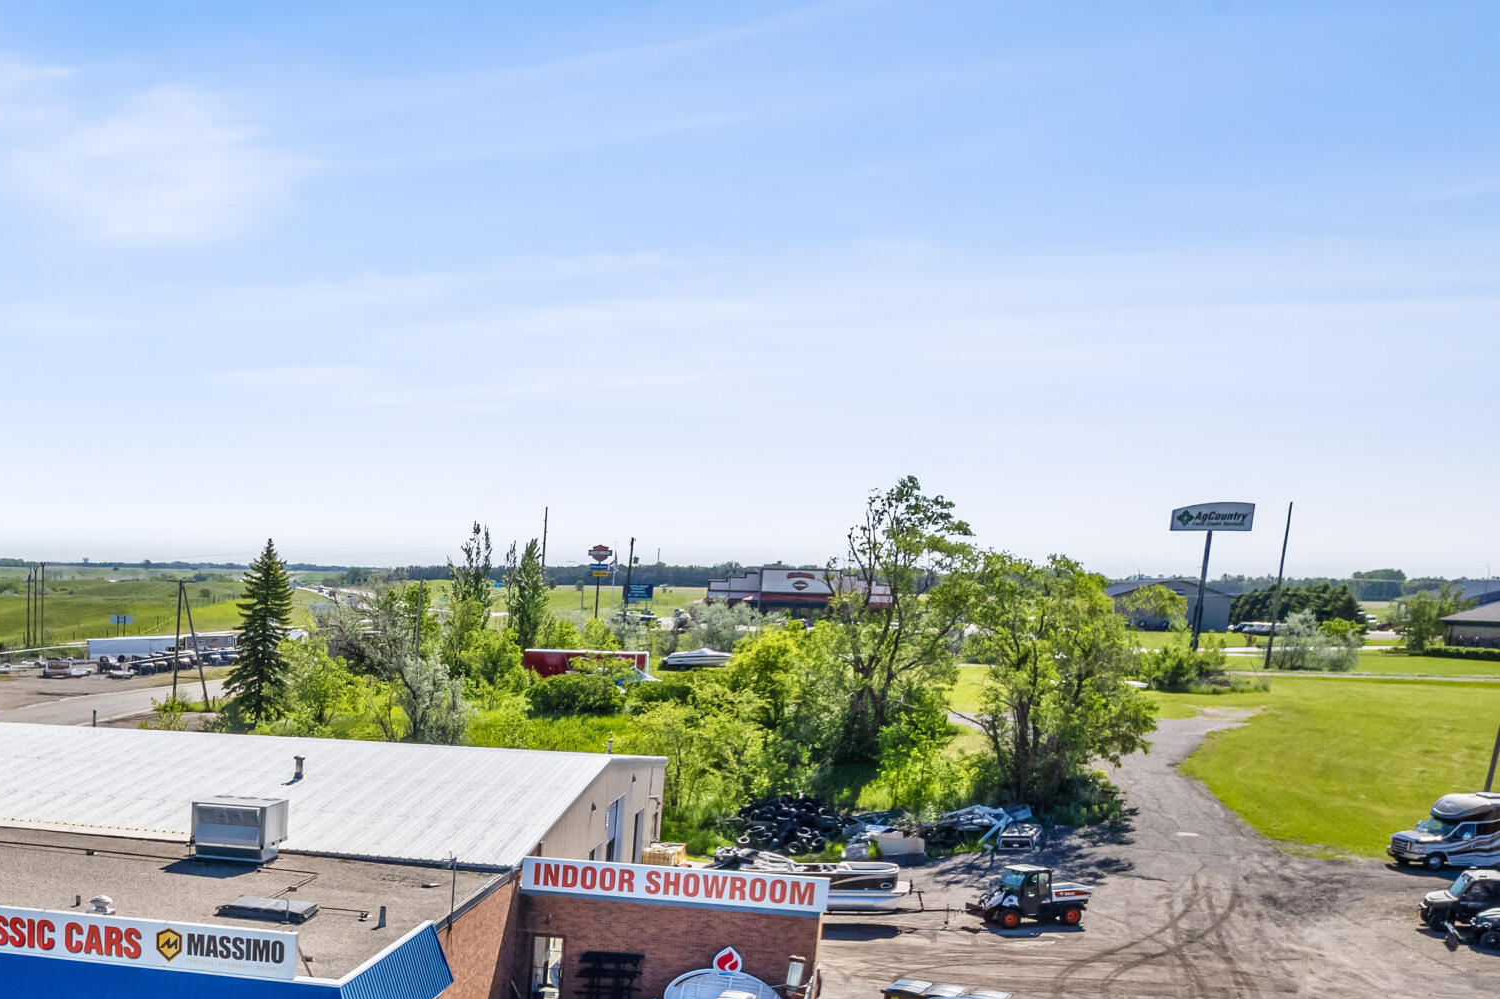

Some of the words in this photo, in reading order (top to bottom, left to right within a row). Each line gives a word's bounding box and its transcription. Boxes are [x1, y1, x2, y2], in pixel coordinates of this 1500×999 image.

[1195, 511, 1248, 523] AgCountry
[533, 862, 635, 892] INDOOR
[645, 870, 815, 906] SHOWROOM
[64, 921, 142, 959] CARS
[187, 933, 285, 964] MASSIMO
